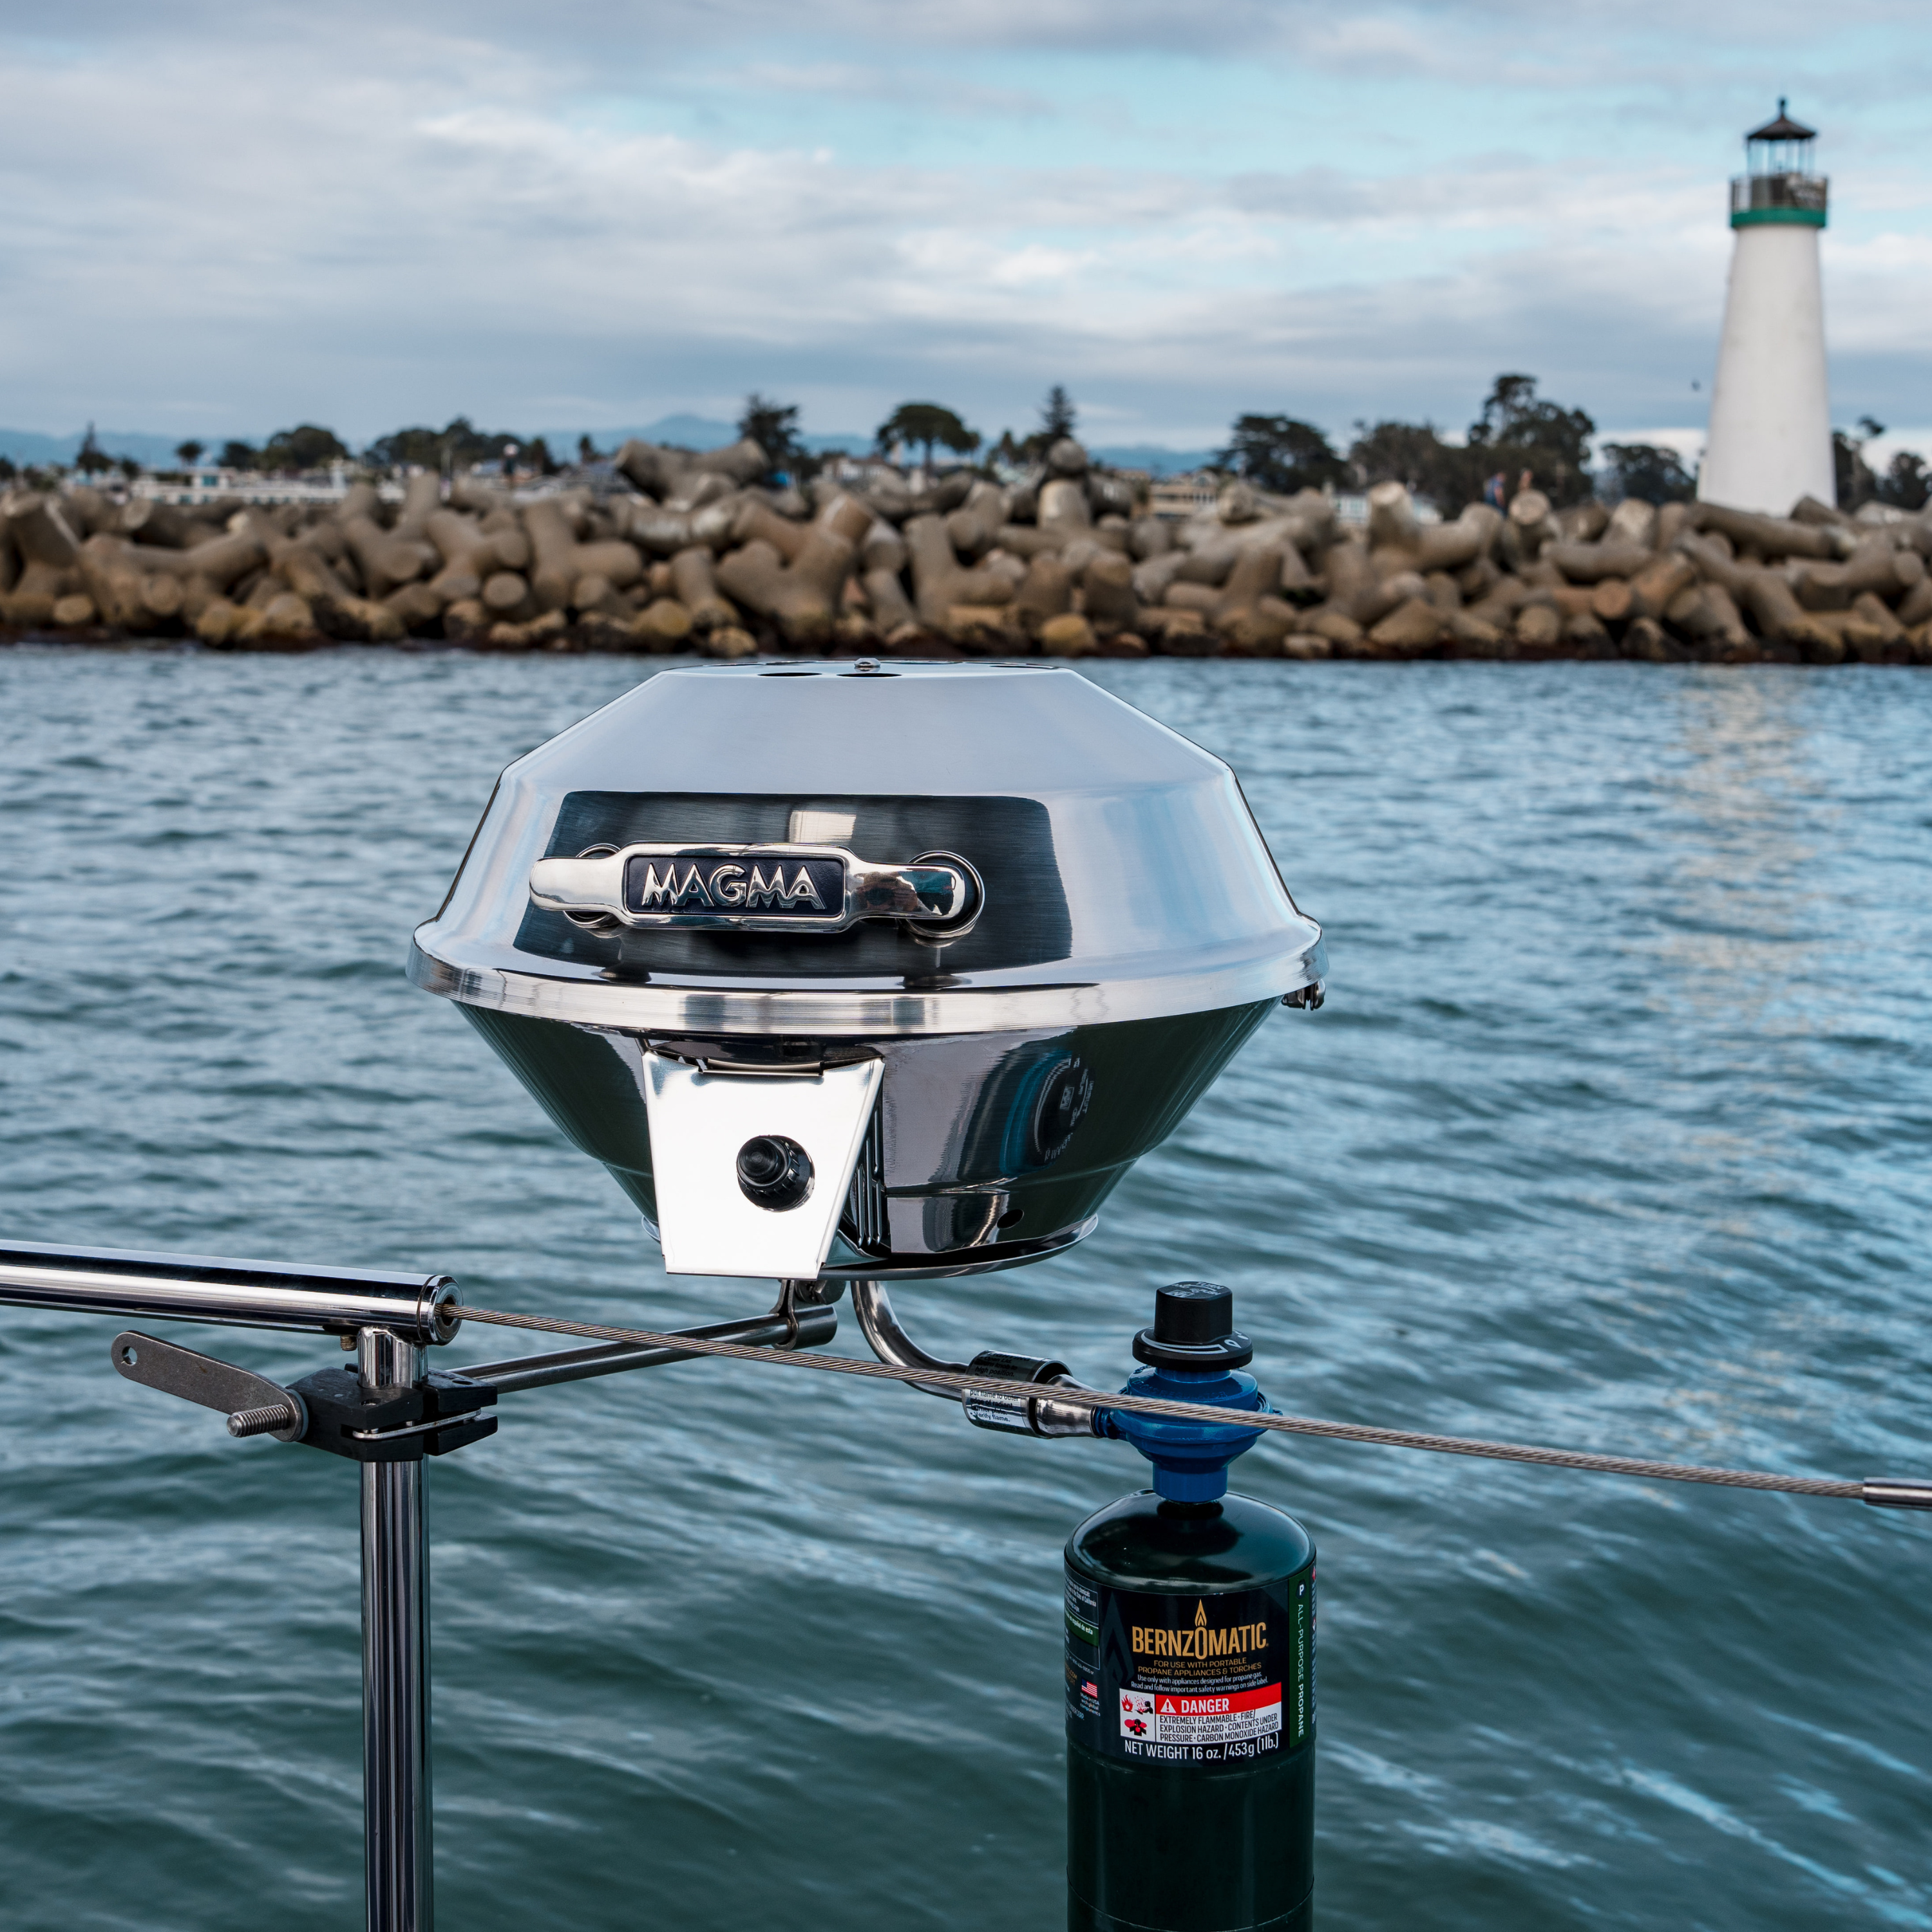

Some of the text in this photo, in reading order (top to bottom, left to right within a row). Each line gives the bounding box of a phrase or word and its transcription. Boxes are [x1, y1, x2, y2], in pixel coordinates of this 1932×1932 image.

[641, 863, 826, 909] MAGMA
[989, 1368, 1015, 1378] position.
[992, 1400, 1014, 1409] radiant
[974, 1411, 991, 1420] Verify
[1299, 1584, 1305, 1596] P
[1132, 1622, 1267, 1660] BERNZOMATIC
[1138, 1666, 1172, 1676] PROPANE
[1174, 1668, 1221, 1676] APPLIANCES
[1229, 1662, 1262, 1674] TORCHES
[1153, 1660, 1169, 1668] FOR
[1209, 1657, 1247, 1668] PORTABLE
[1147, 1675, 1159, 1684] only
[1171, 1677, 1200, 1686] appliances
[1200, 1676, 1224, 1686] designed
[1232, 1672, 1253, 1683] propane
[1153, 1683, 1170, 1692] follow
[1170, 1684, 1198, 1694] important
[1198, 1683, 1215, 1694] safety
[1215, 1681, 1240, 1692] warnings
[1247, 1679, 1256, 1687] side
[1256, 1676, 1269, 1685] label.
[1181, 1698, 1229, 1713] DANGER
[1160, 1709, 1256, 1725] EXTREMELY FLAMMABLE FIRE/
[1160, 1713, 1278, 1733] EXPLOSION HAZARD CONTENTS UNDER
[1160, 1721, 1279, 1742] PRESSURE CARBON MONOXIDE HAZARD
[1124, 1739, 1143, 1755] NET
[1146, 1743, 1189, 1759] WEIGHT
[1191, 1747, 1204, 1759] 16
[1206, 1748, 1221, 1759] oz.
[1256, 1732, 1279, 1754] (1lb.)
